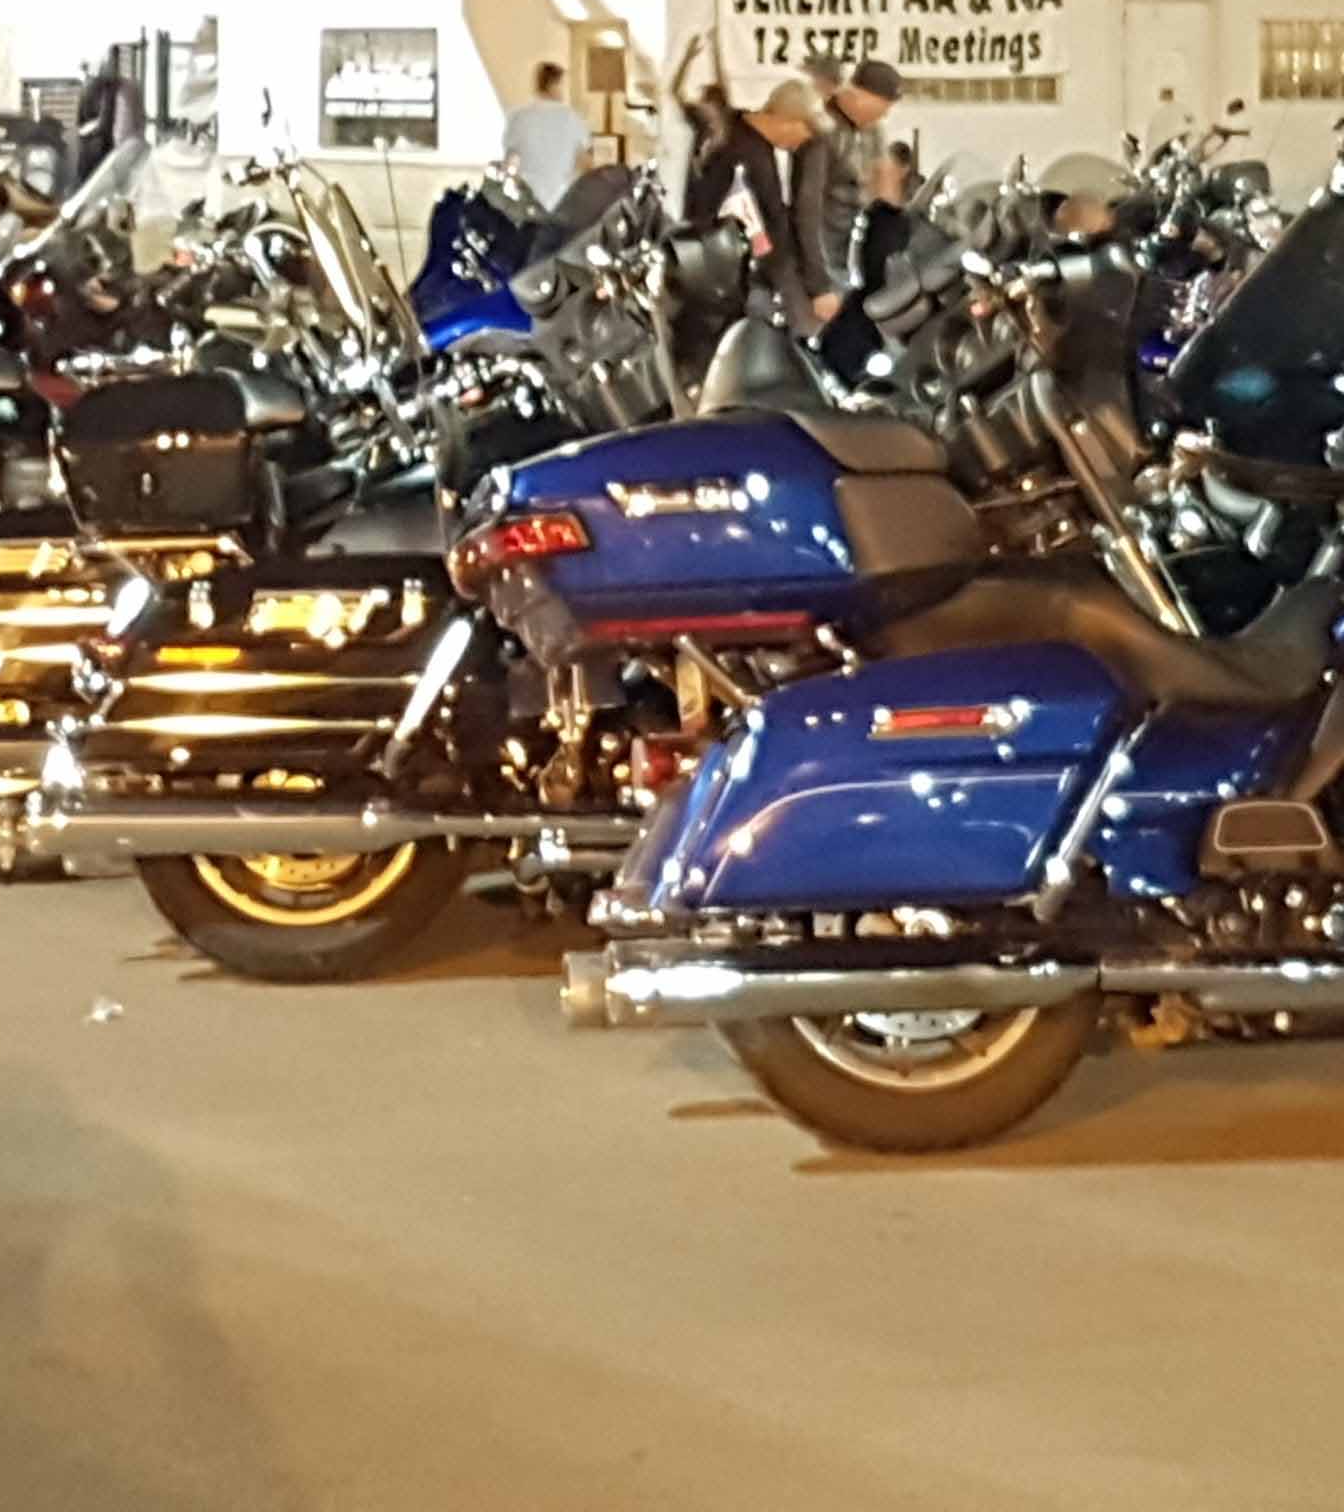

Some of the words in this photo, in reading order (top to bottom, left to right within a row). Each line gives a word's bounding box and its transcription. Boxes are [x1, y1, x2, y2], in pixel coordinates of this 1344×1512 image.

[753, 26, 791, 65] 12
[802, 26, 879, 65] STEP
[897, 25, 1042, 74] Meetings
